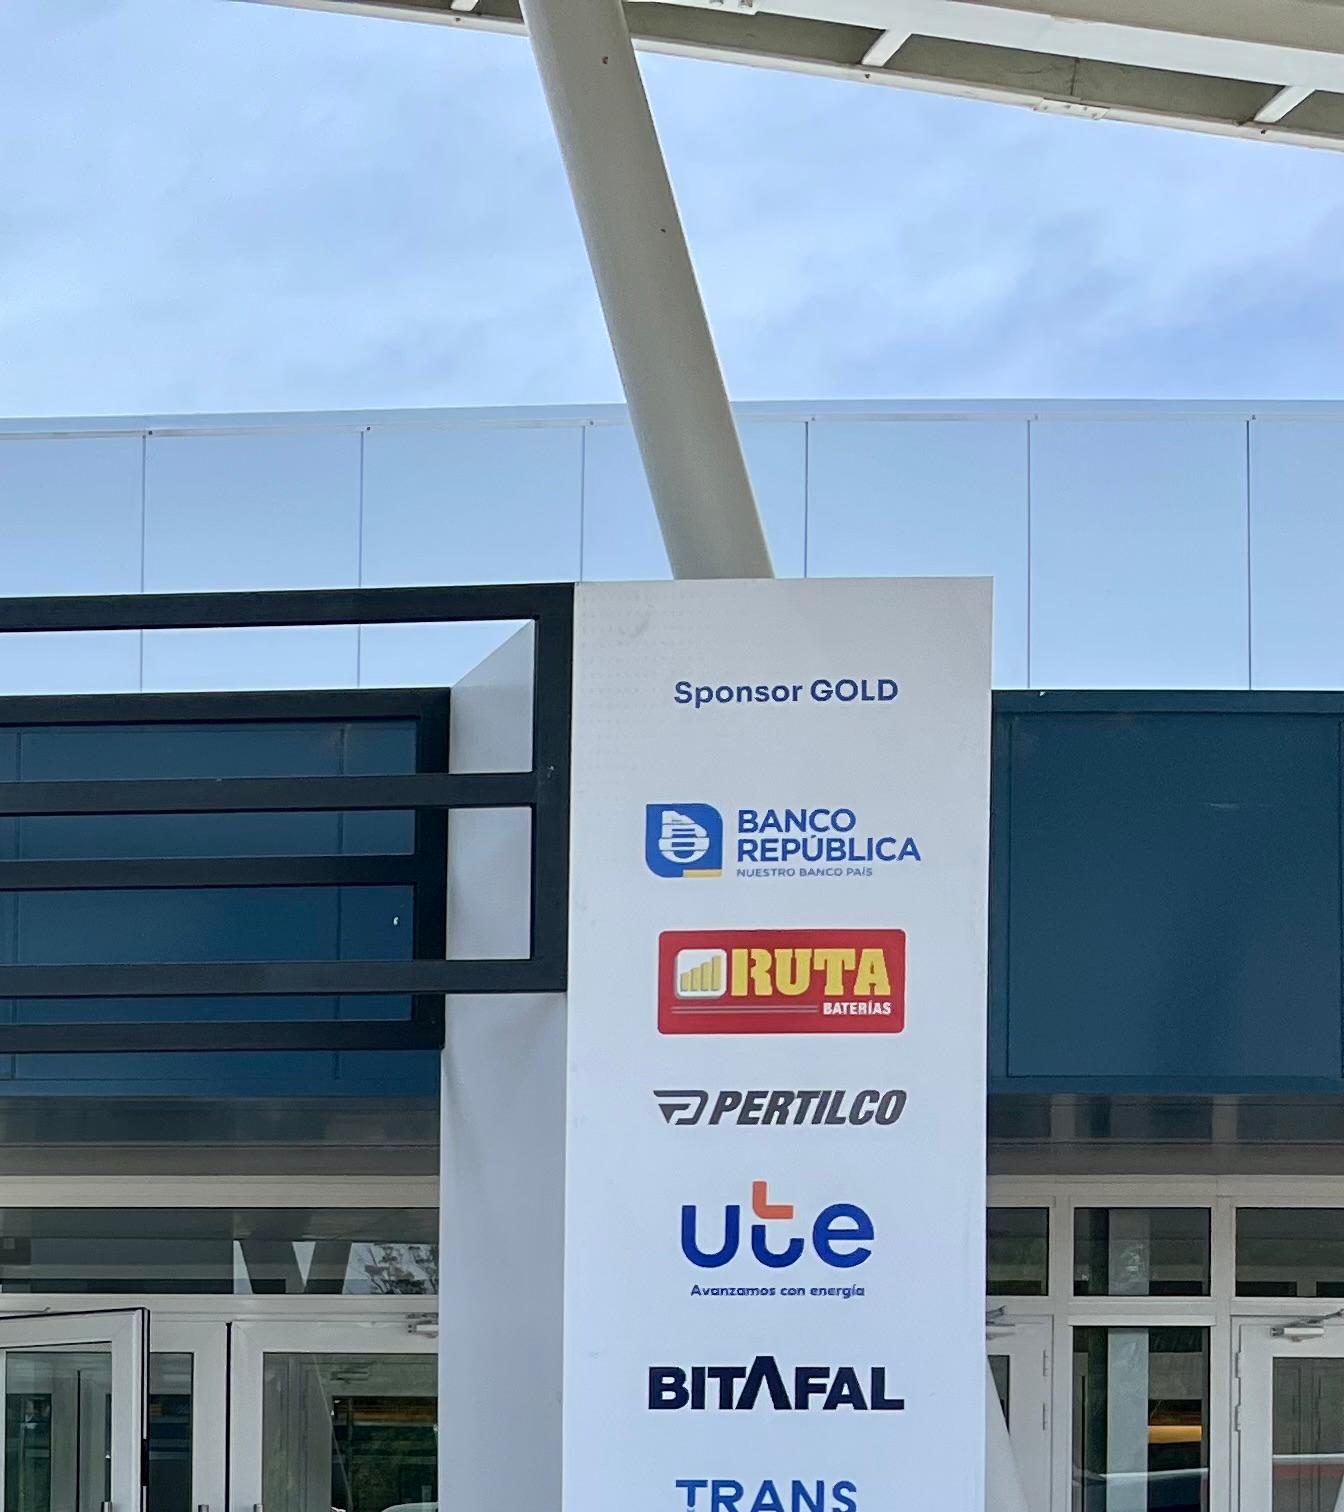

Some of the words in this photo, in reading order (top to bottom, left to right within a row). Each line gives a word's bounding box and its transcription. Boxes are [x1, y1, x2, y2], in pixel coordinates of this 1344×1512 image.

[674, 681, 803, 709] Sponsor
[810, 678, 899, 702] GOLD
[737, 808, 857, 833] BANCO
[736, 834, 921, 862] REPÚBLICA
[736, 867, 796, 877] NUESTRO
[799, 867, 844, 877] BANCO
[730, 947, 891, 997] RUTA
[823, 1000, 892, 1015] BATERÍAS
[708, 1089, 907, 1125] PERTILCO
[681, 1180, 875, 1268] ute
[690, 1284, 776, 1297] Avanzamos
[780, 1286, 806, 1297] con
[810, 1284, 865, 1299] energía
[648, 1355, 905, 1410] BITAFAL
